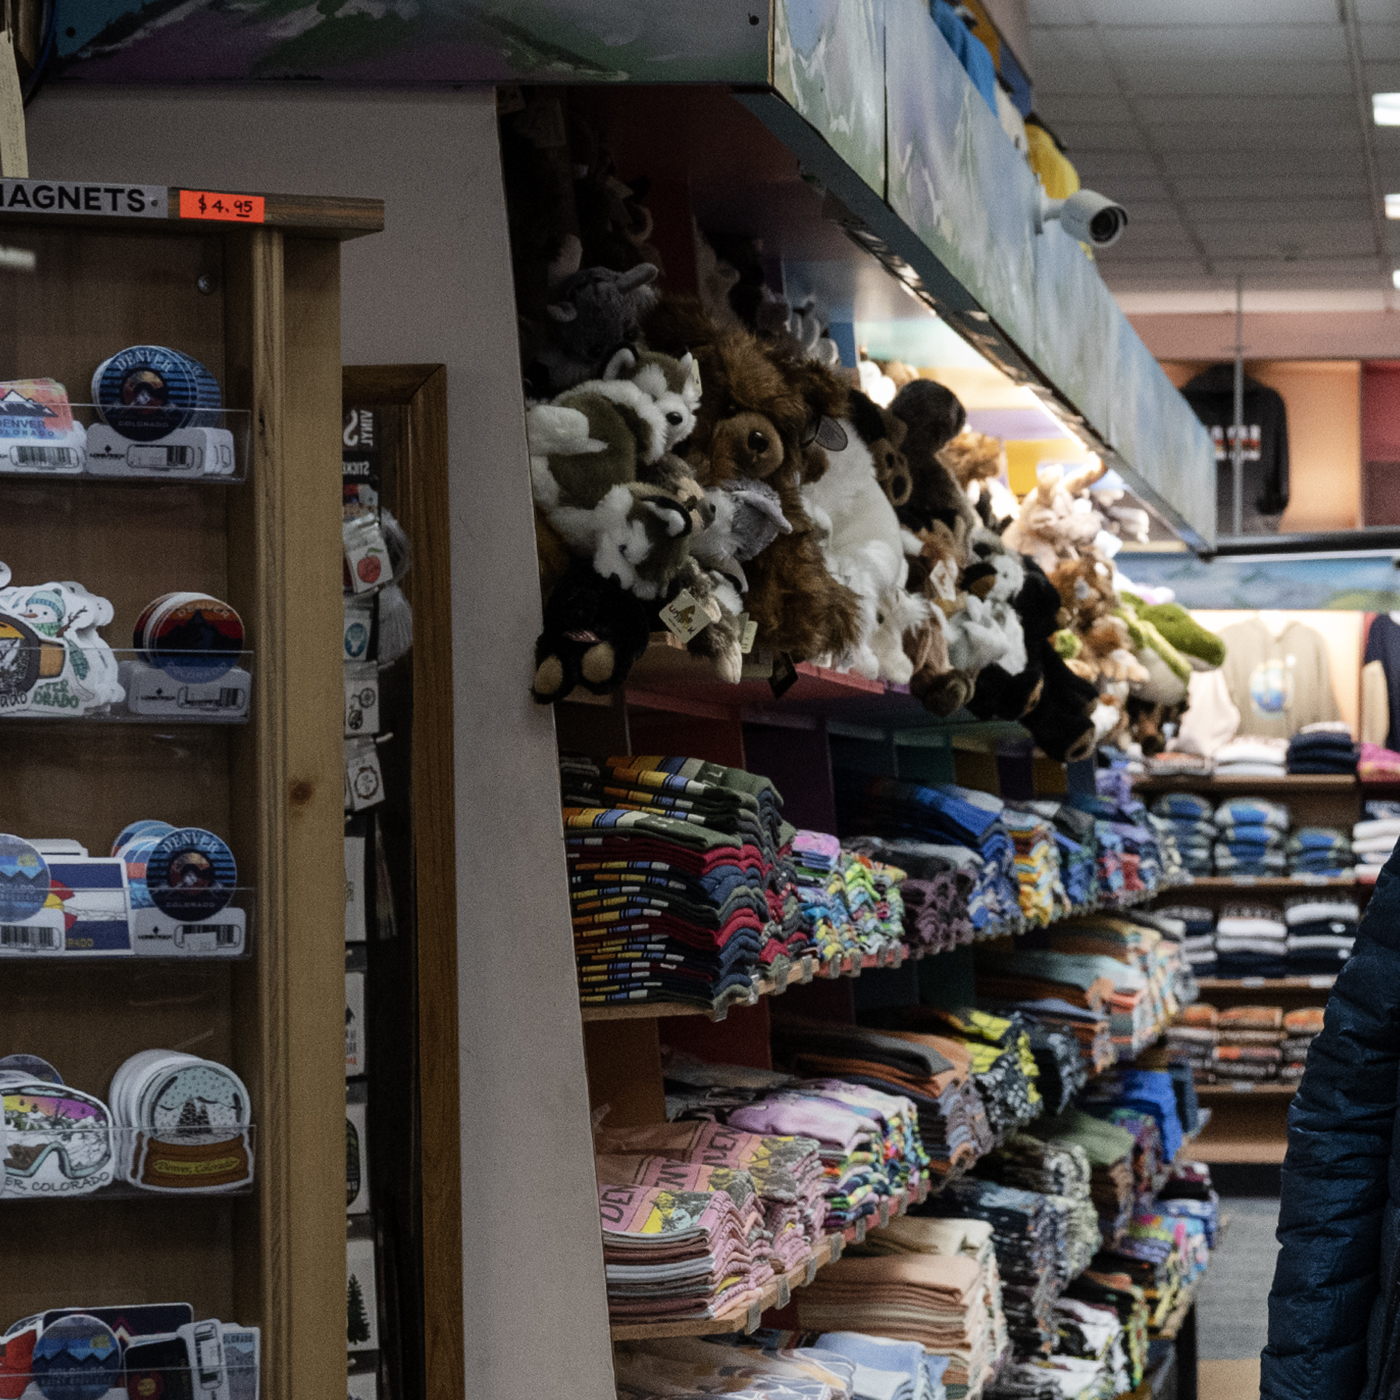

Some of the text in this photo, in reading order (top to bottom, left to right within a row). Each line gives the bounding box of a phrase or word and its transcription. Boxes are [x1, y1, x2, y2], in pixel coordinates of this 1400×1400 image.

[116, 352, 173, 374] DENVER
[117, 420, 170, 429] COLORADO
[163, 834, 220, 855] DENVER
[164, 900, 217, 909] COLORADO
[31, 1172, 109, 1193] COLORADO
